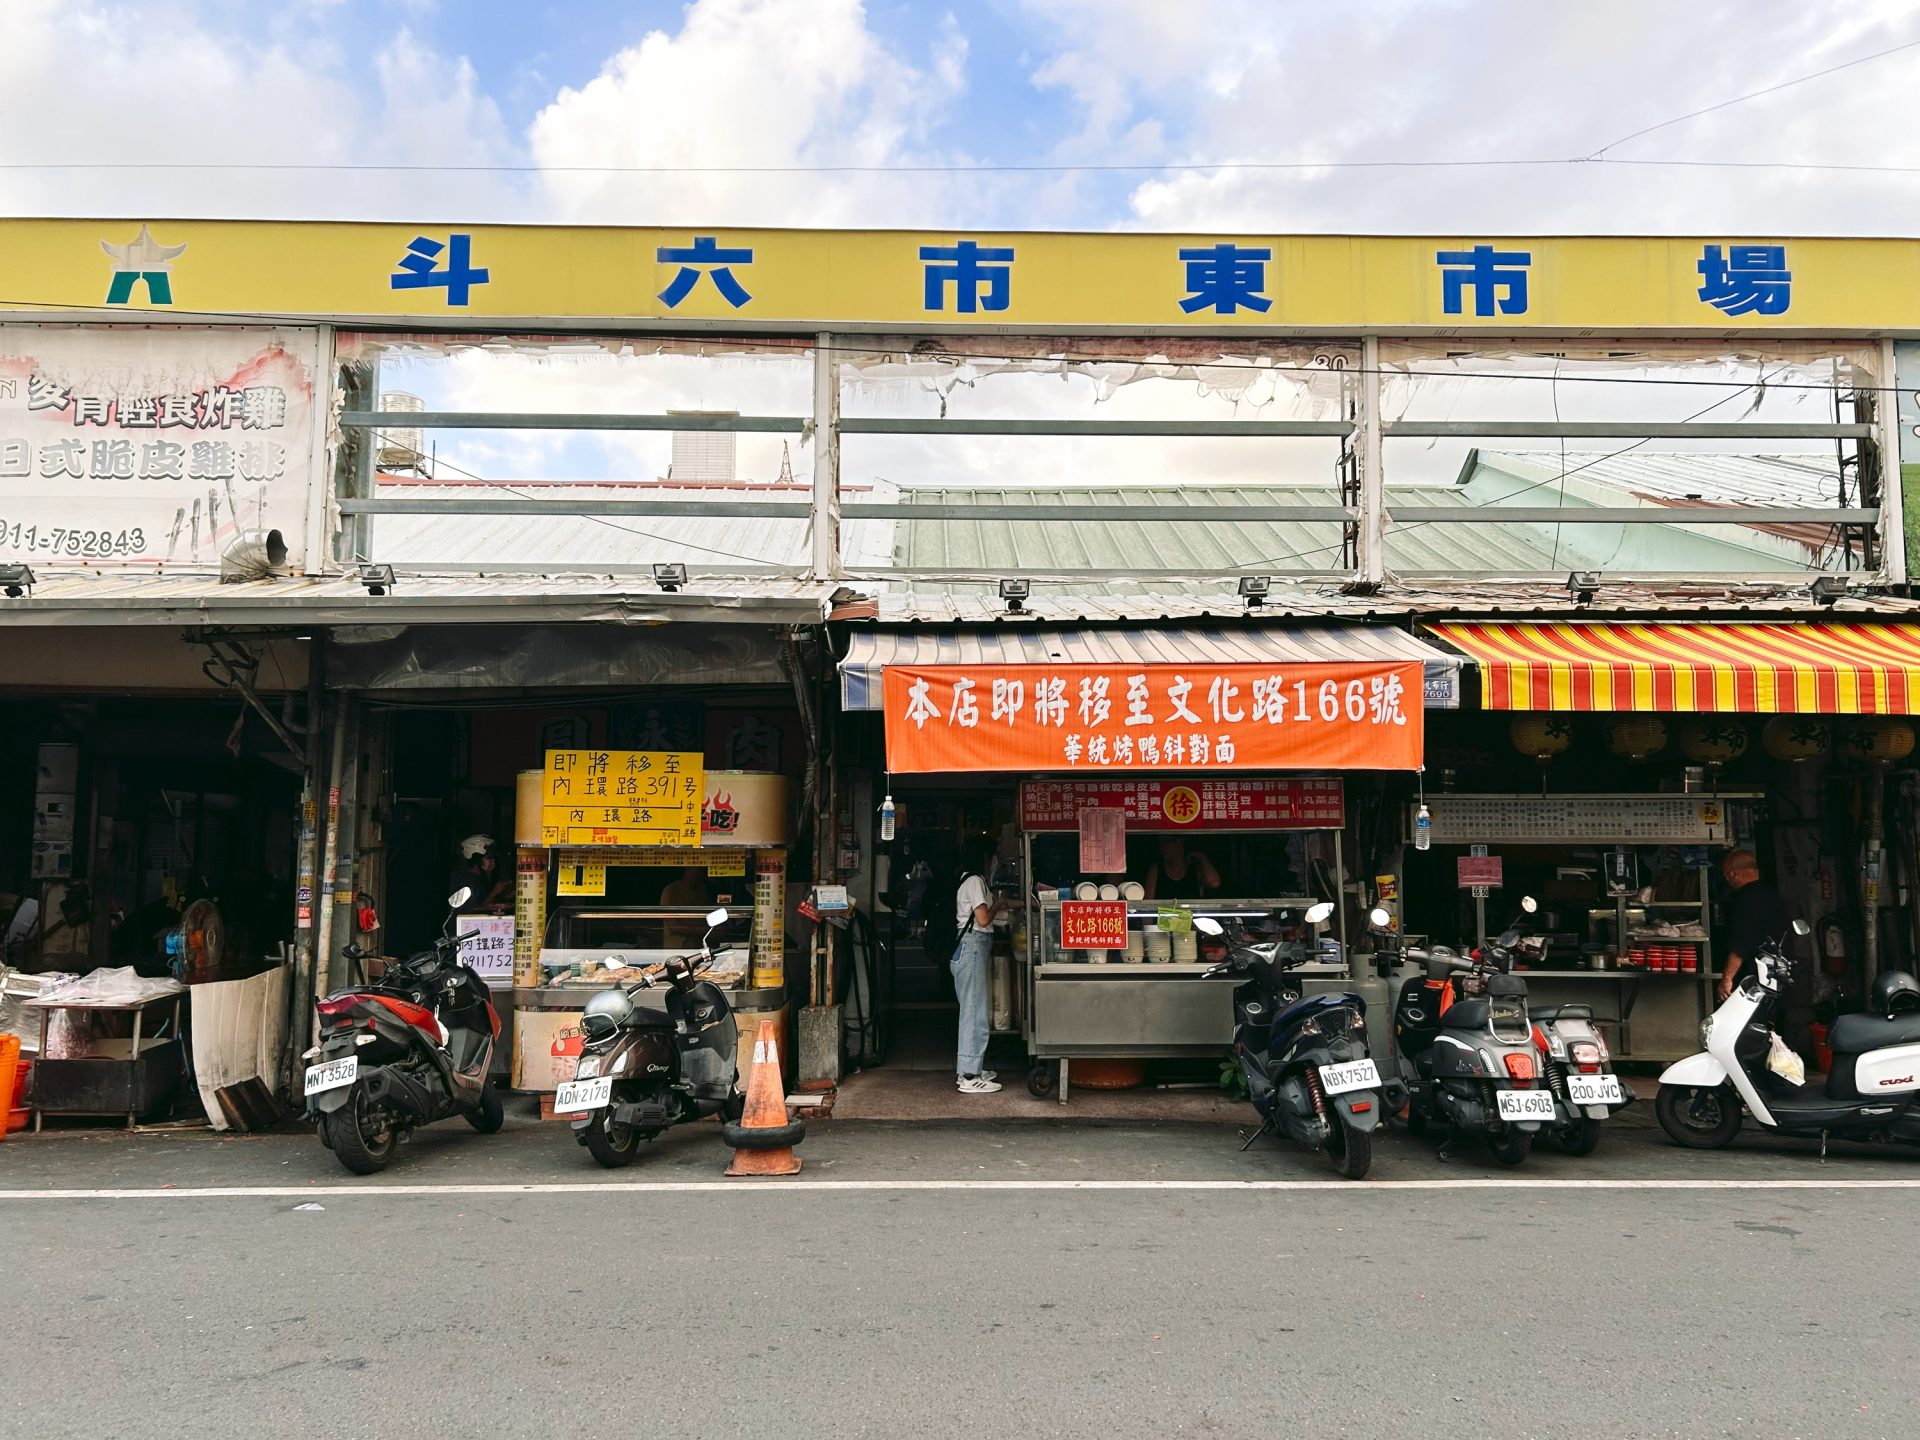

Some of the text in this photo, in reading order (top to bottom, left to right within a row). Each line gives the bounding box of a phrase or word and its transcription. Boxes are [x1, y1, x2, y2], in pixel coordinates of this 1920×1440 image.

[391, 230, 1792, 320] 斗六市東市場
[904, 673, 1408, 729] 本店即將移至文化路166號
[1063, 733, 1236, 766] 華統烤鴨斜對面
[554, 752, 681, 776] 即將移至
[570, 809, 653, 823] 內環路
[1170, 791, 1195, 818] 徐
[682, 801, 698, 838] 中正路
[701, 809, 740, 829] 吃!
[1068, 905, 1121, 914] 本店即將移至
[1066, 917, 1124, 935] 文化路166號
[557, 1085, 609, 1106] ADN-2178
